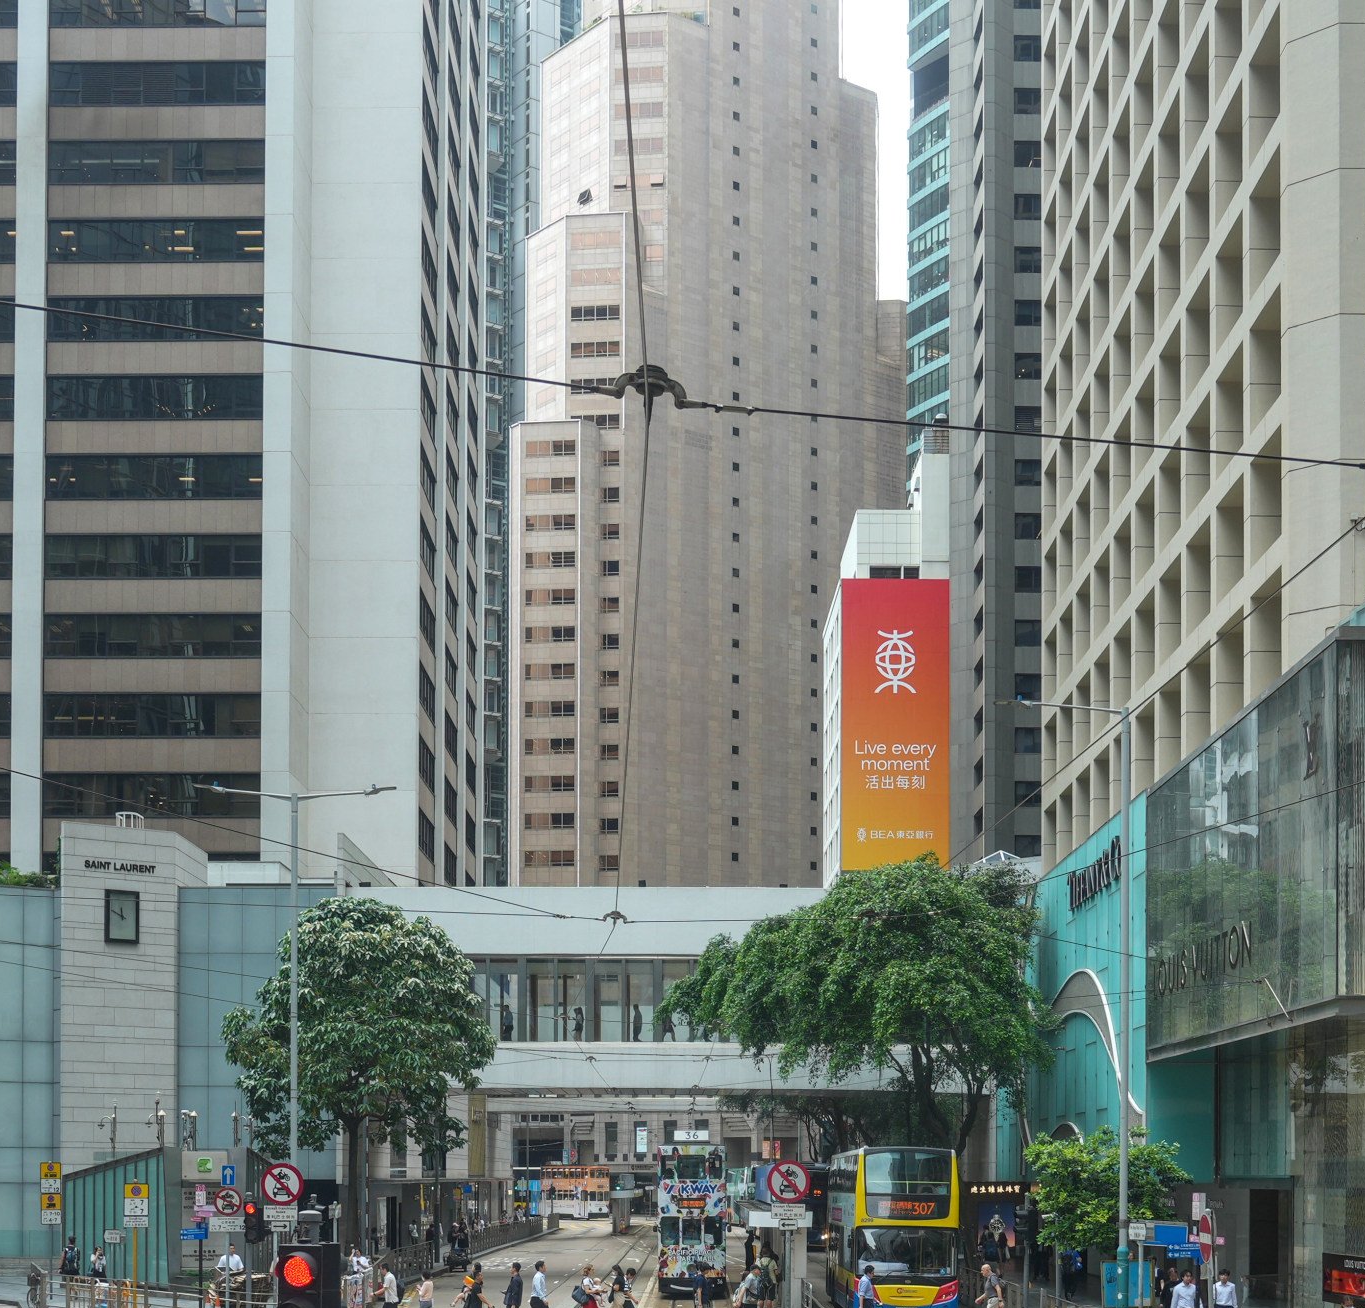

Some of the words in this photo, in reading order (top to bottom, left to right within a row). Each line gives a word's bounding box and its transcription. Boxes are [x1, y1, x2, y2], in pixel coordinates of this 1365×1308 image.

[855, 740, 886, 754] Live
[892, 743, 936, 758] every
[861, 758, 930, 770] moment
[865, 775, 925, 789] 活出每刻
[870, 830, 895, 839] BEA
[896, 830, 934, 840] 東亞銀行
[84, 859, 112, 872] SAINT
[114, 861, 157, 875] LAURENT
[1191, 920, 1252, 985] VUITTON
[685, 1131, 699, 1140] 36
[912, 1202, 935, 1215] 307
[1344, 1259, 1355, 1268] LOUIS
